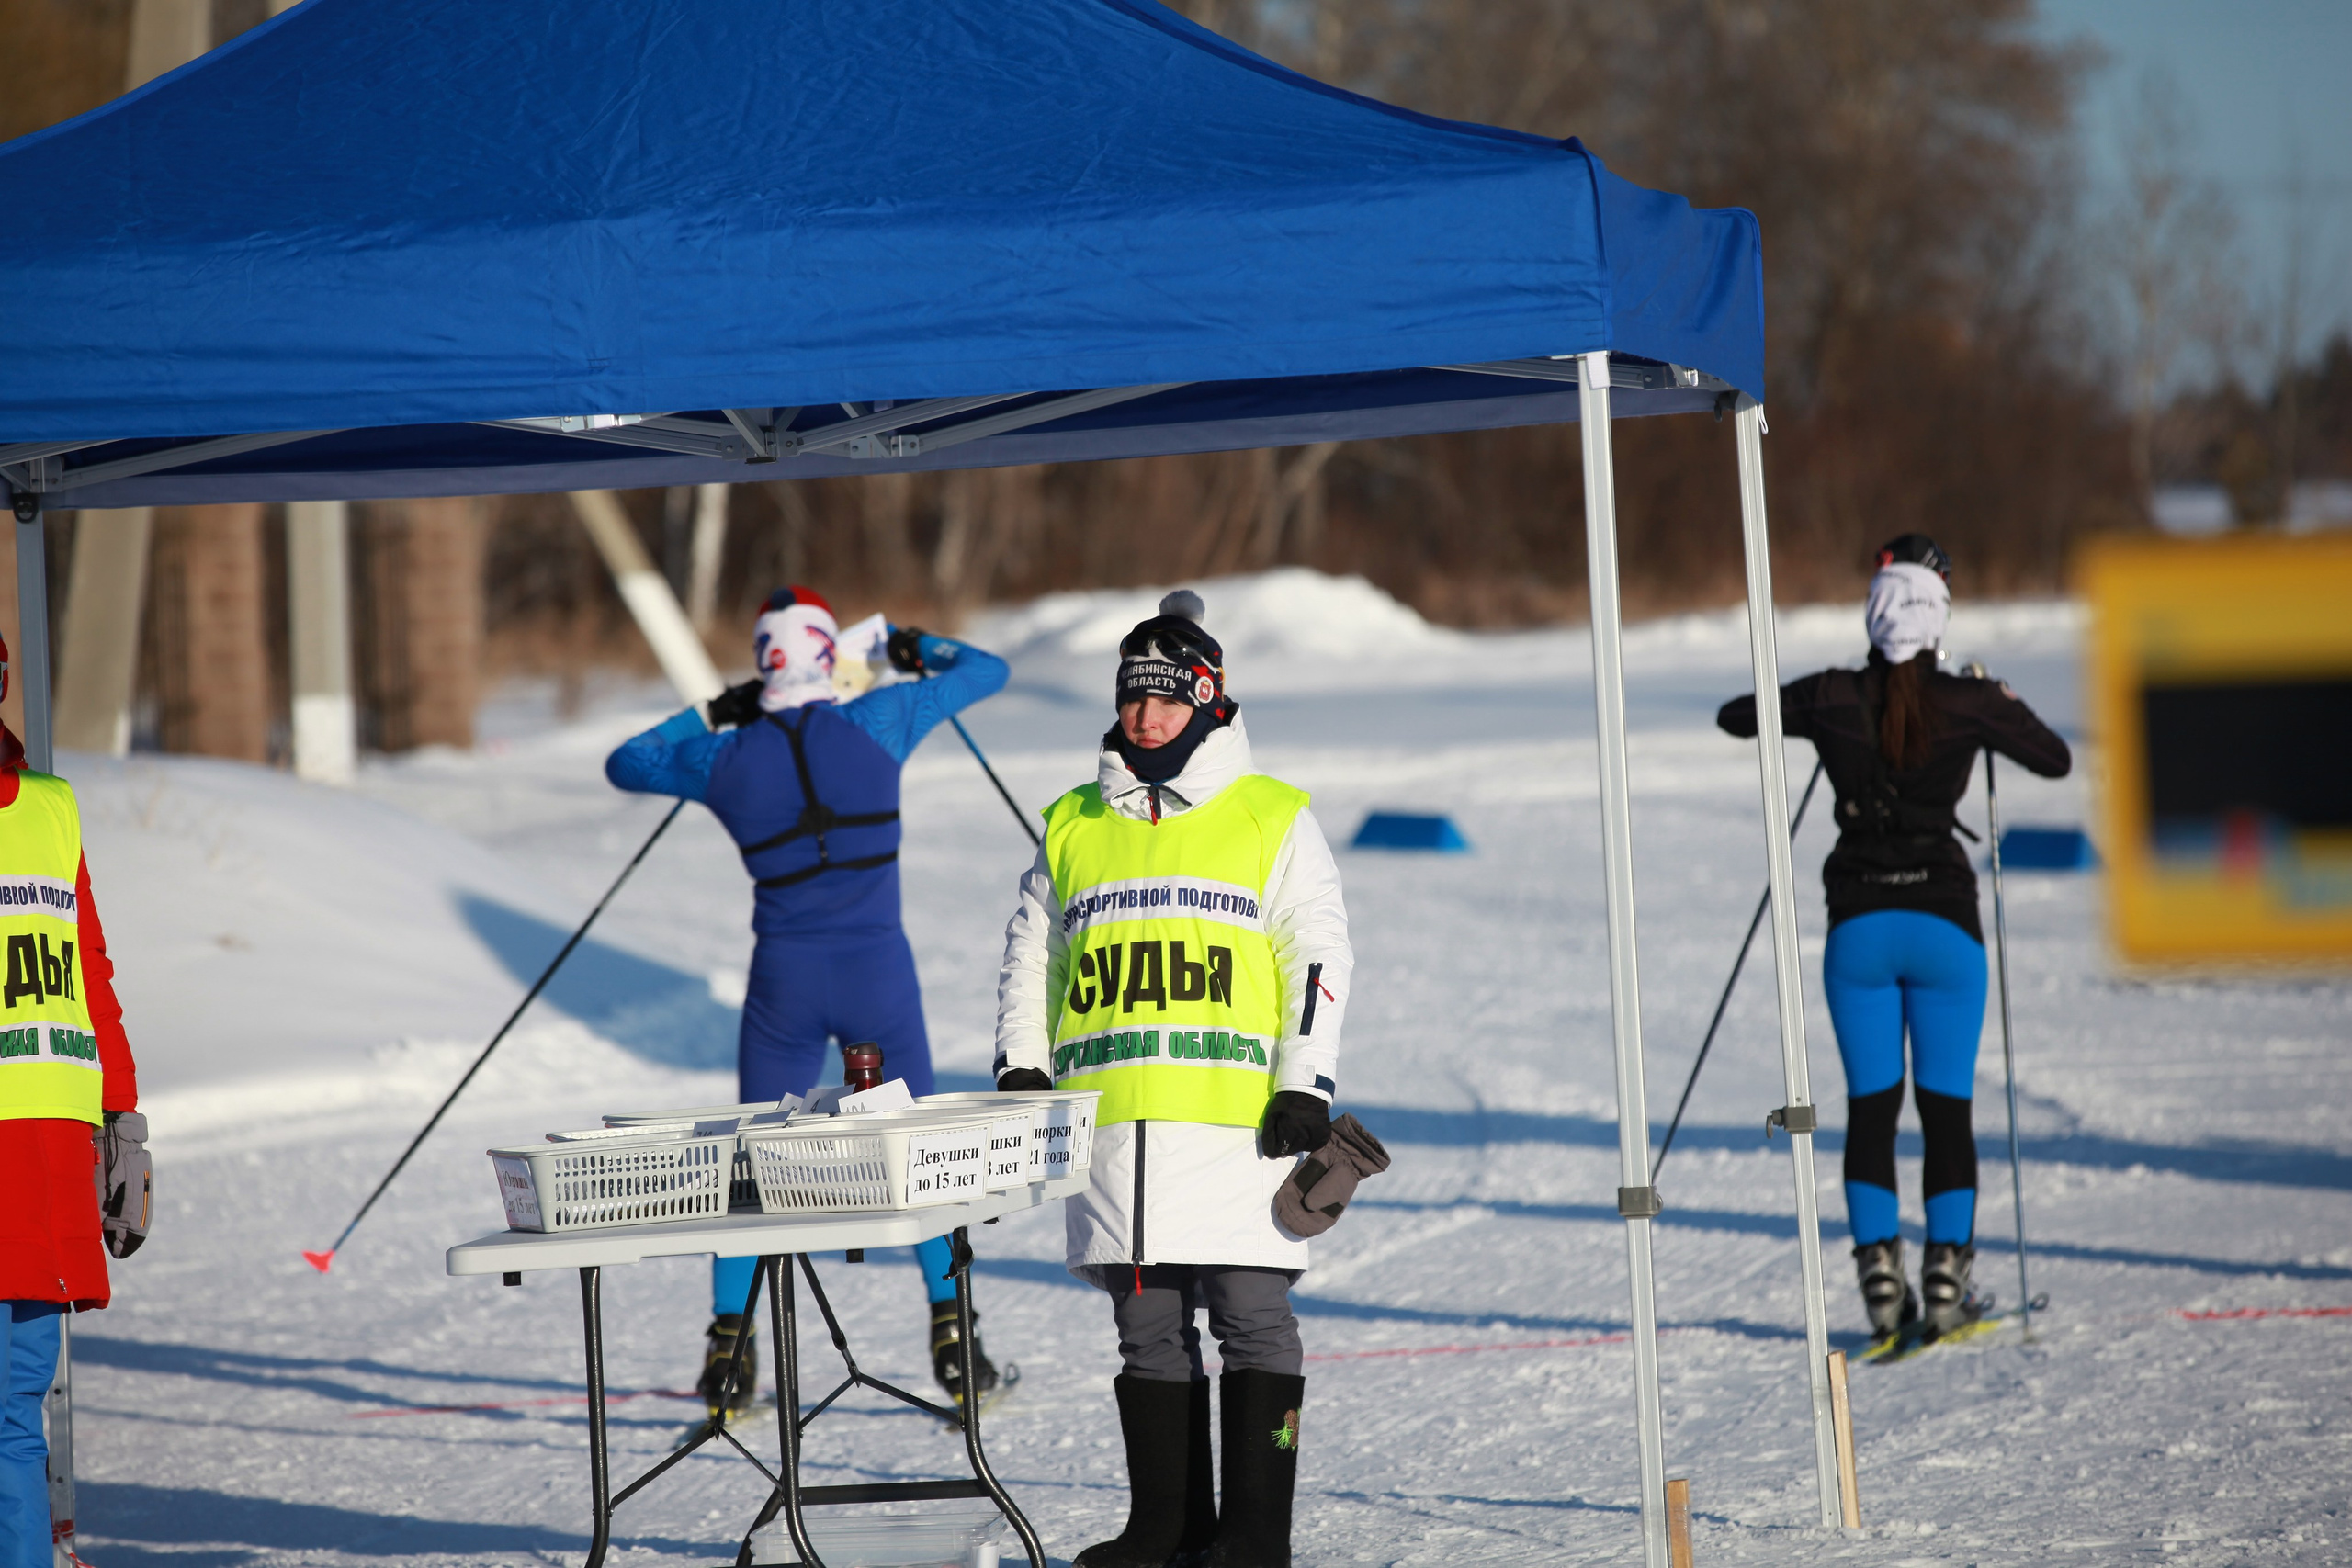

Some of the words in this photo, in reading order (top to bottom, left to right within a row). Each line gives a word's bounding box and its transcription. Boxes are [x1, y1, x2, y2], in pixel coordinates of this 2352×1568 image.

[1122, 664, 1192, 681] ЧЕЛЯБИНСКАЯ
[1127, 677, 1176, 689] ОБЛАСТЬ
[1069, 940, 1233, 1015] СУДЬЯ
[1054, 1030, 1159, 1076] УРГАНСКАЯ
[1168, 1031, 1267, 1066] ОБЛАСТЬ
[914, 1147, 979, 1168] Девушки
[1044, 1150, 1070, 1165] года
[996, 1161, 1020, 1176] лет
[914, 1179, 930, 1193] до
[935, 1172, 950, 1189] 15
[953, 1173, 977, 1188] лет
